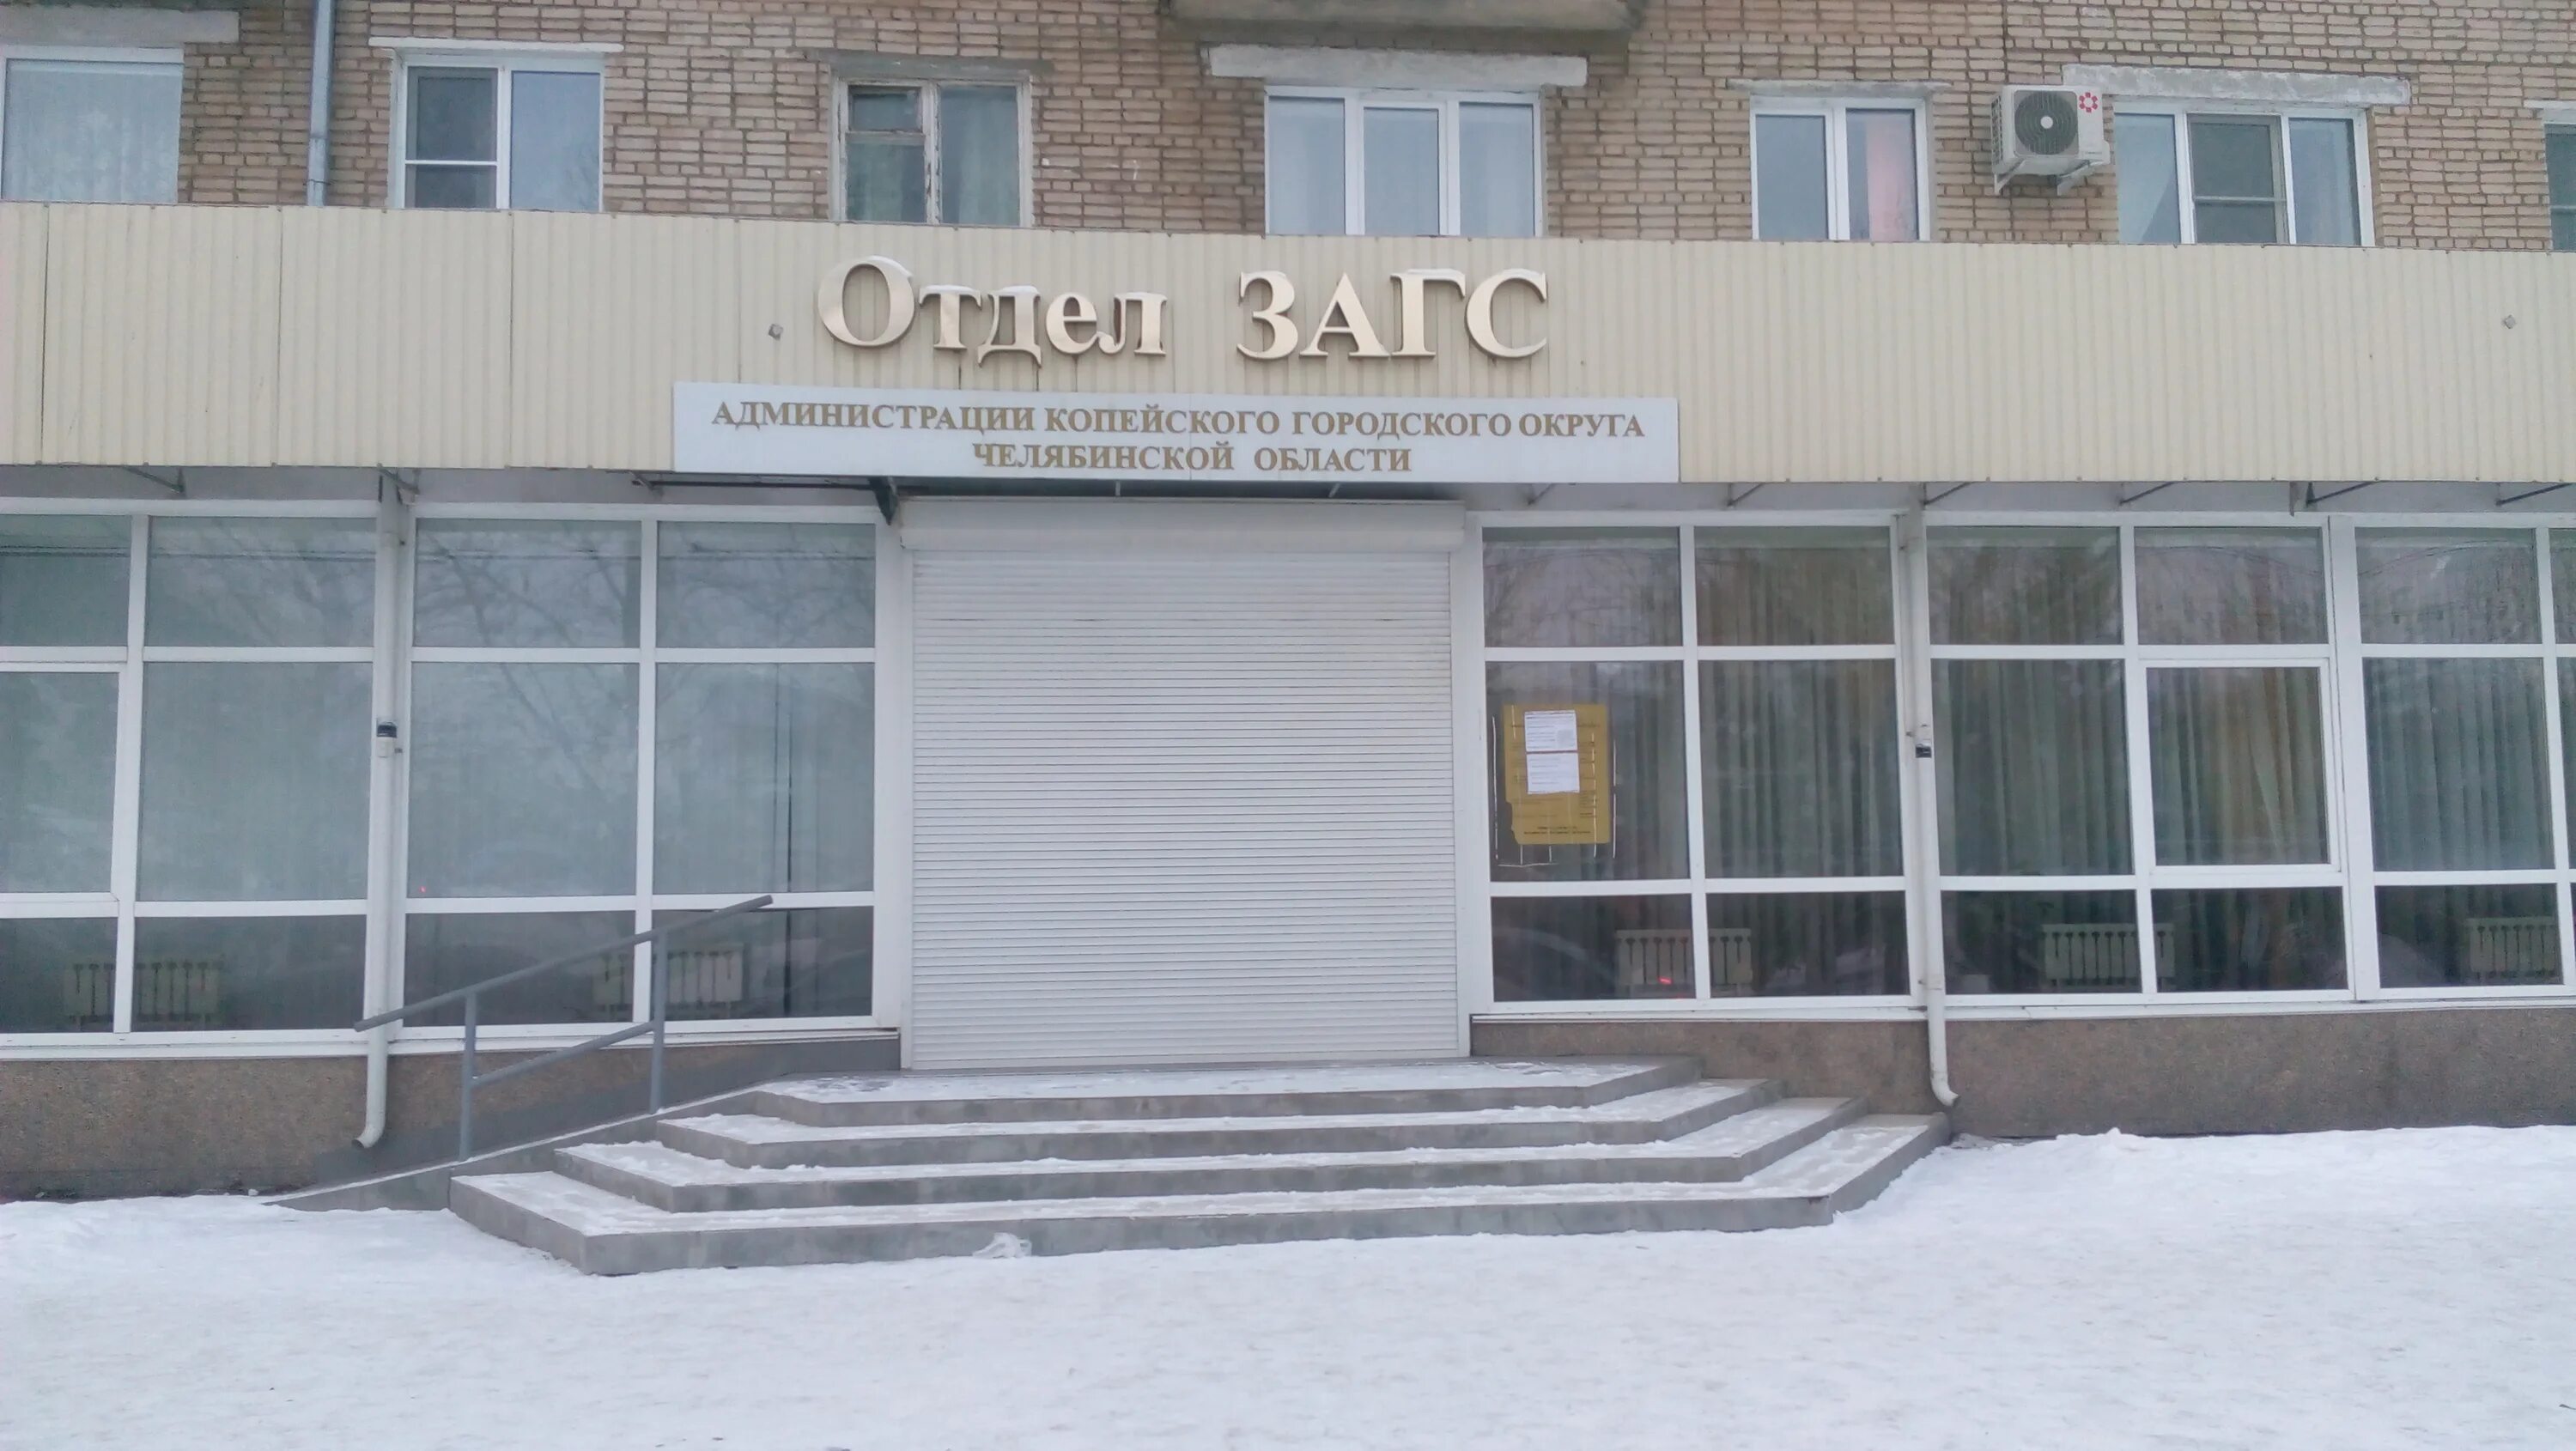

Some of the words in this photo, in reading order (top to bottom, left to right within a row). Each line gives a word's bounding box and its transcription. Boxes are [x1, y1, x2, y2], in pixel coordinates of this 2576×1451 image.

[817, 255, 1168, 367] Отдел
[1236, 268, 1548, 360] ЗАГС
[711, 400, 1036, 434] АДМИНИСТРАЦИИ
[1045, 404, 1280, 435] КОПЕЙСКОГО
[1291, 410, 1512, 440] ГОРОДСКОГО
[1518, 413, 1645, 438] ОКРУГА
[973, 440, 1235, 471] ЧЕЛЯБИНСКОЙ
[1253, 446, 1413, 473] ОБЛАСТИ
